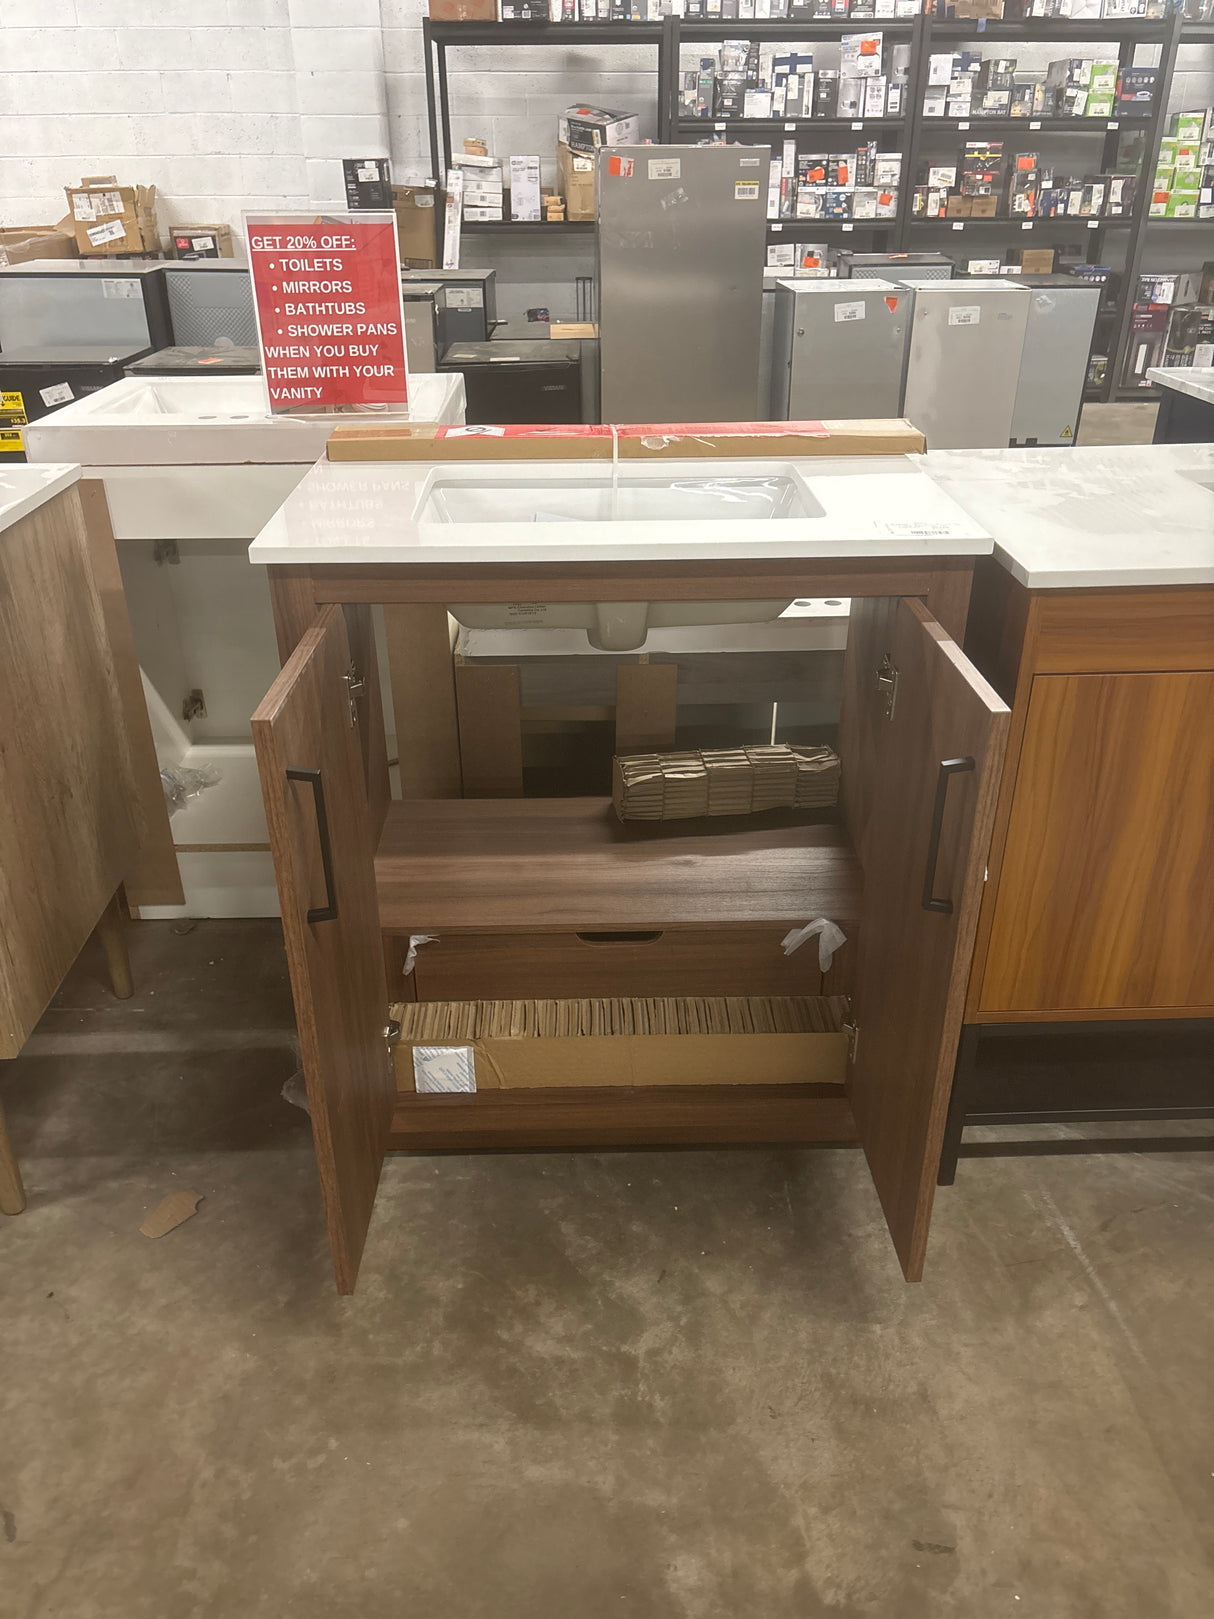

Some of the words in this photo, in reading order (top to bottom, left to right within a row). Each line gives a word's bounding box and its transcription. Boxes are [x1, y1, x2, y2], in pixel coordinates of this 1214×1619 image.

[252, 236, 282, 249] GET
[286, 236, 317, 249] 20%
[321, 235, 356, 249] OFF:
[279, 259, 342, 271] TOILETS
[283, 281, 352, 293] MIRRORS
[285, 303, 365, 315] BATHTUBS
[288, 324, 353, 336] SHOWER
[357, 323, 397, 335] PANS
[265, 346, 309, 358] WHEN
[314, 345, 344, 357] YOU
[349, 345, 378, 356] BUY
[268, 367, 309, 378] THEM
[312, 366, 349, 377] WITH
[353, 365, 394, 377] YOUR
[271, 387, 322, 399] VANITY
